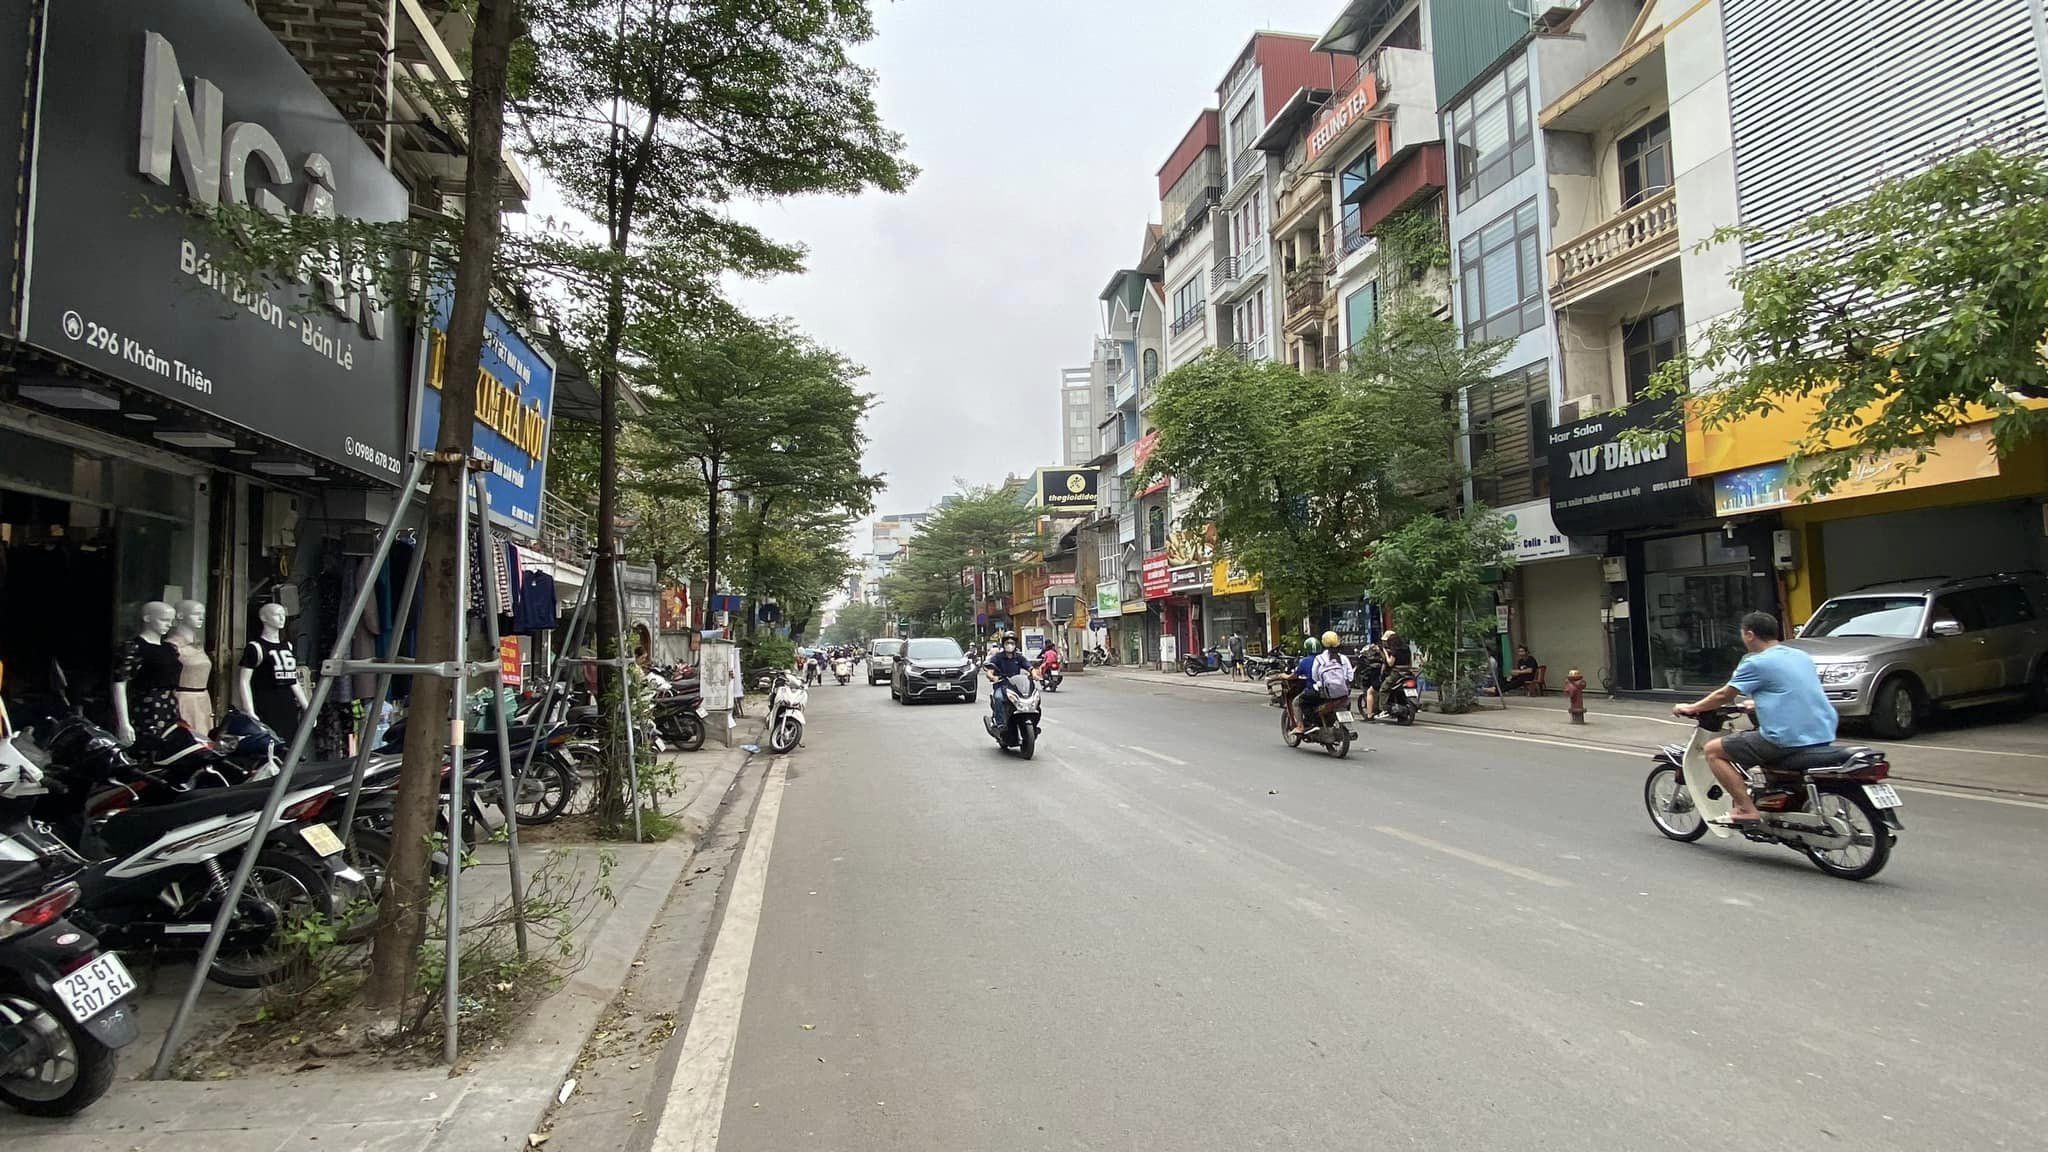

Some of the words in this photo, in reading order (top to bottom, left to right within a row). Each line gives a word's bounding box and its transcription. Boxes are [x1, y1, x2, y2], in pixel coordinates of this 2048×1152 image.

[1312, 107, 1347, 156] FEELING
[1347, 88, 1367, 122] TEA
[86, 321, 119, 355] 296
[123, 337, 170, 378] Khâm
[173, 359, 213, 395] Thiên
[302, 316, 333, 359] Bán
[336, 338, 353, 371] Lẻ
[501, 381, 522, 447] HÀ
[520, 398, 546, 471] NỘI
[1549, 430, 1570, 445] Hair
[1573, 422, 1603, 438] Salon
[355, 441, 374, 463] 0988
[375, 451, 388, 470] 678
[388, 456, 400, 474] 220
[268, 649, 296, 671] 16
[65, 959, 115, 998] 29-G1
[72, 974, 131, 1018] 507.64
